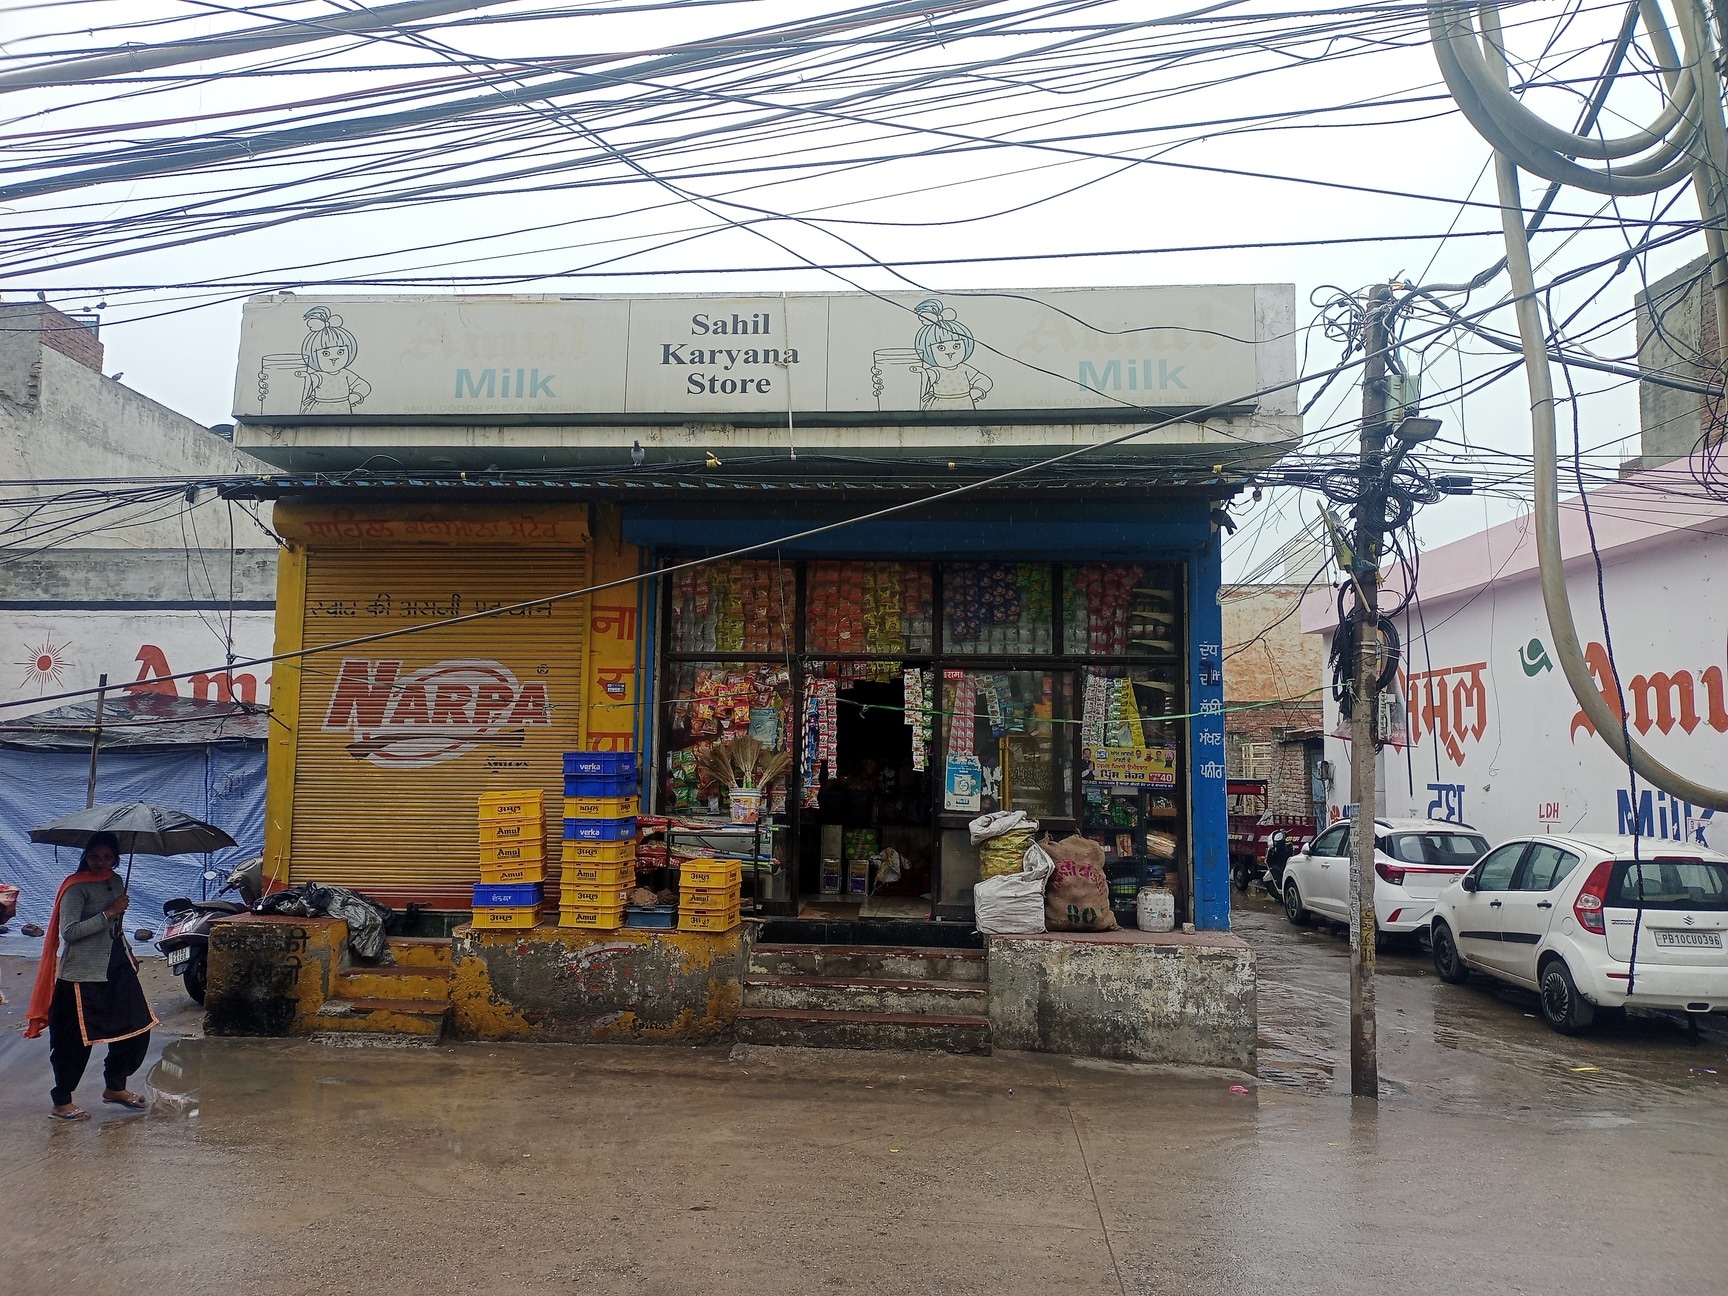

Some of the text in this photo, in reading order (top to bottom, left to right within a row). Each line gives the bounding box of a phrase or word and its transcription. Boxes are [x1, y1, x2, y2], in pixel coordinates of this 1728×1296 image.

[691, 313, 771, 335] Sahil
[660, 342, 800, 370] Karyana
[453, 368, 557, 399] Milk
[686, 371, 772, 396] Store
[1079, 359, 1188, 392] Milk
[365, 593, 392, 618] की
[122, 644, 272, 705] Am
[321, 658, 552, 732] NARPA
[580, 763, 601, 771] verka
[1160, 773, 1173, 782] 40
[1539, 802, 1560, 819] LDH
[497, 827, 521, 836] Amul
[580, 829, 600, 837] verka
[497, 848, 521, 857] Amul
[500, 871, 524, 880] Amul
[576, 869, 597, 878] Amul
[1662, 933, 1720, 946] PB10CU0396
